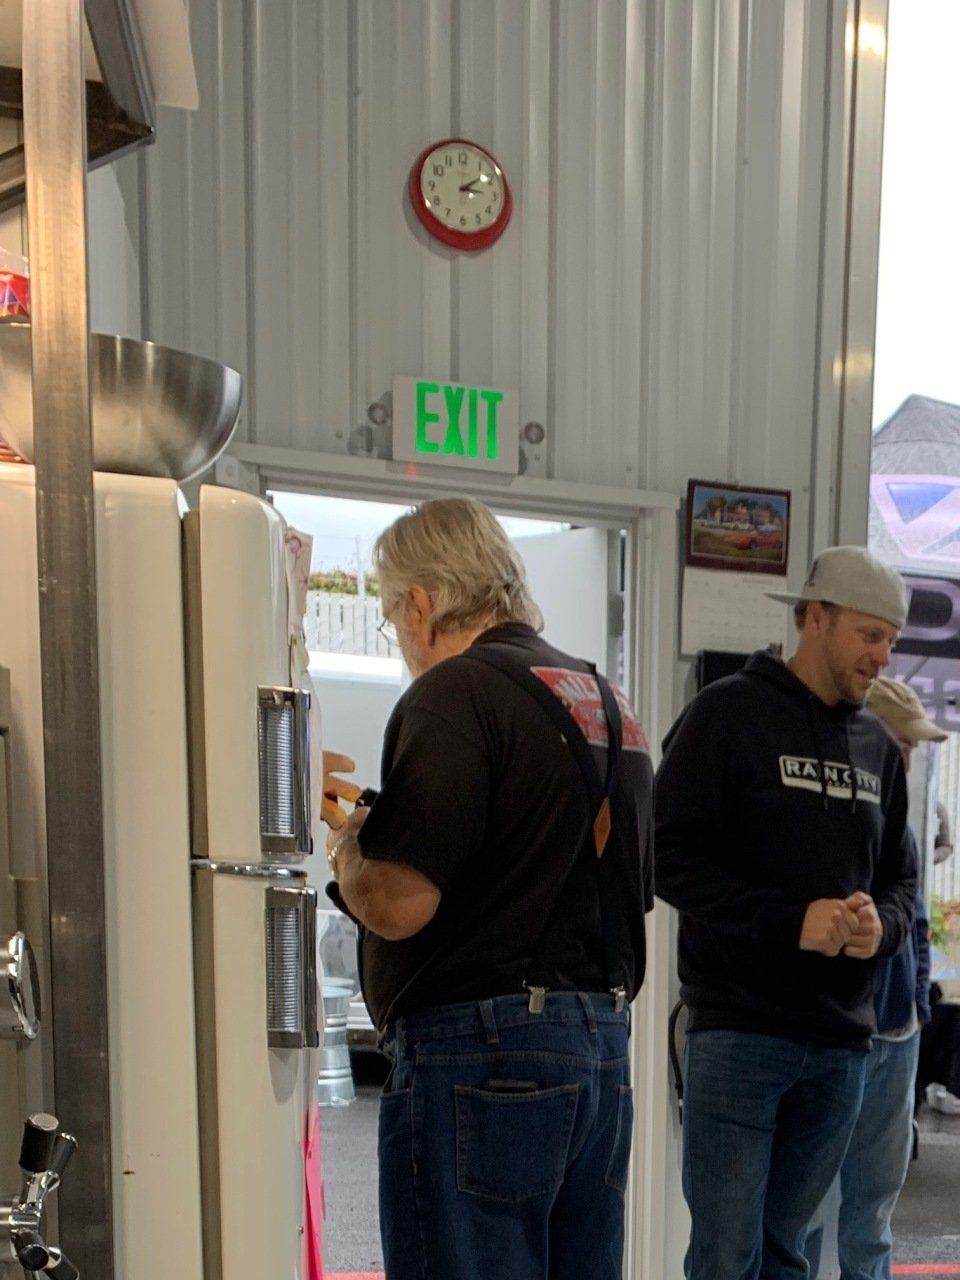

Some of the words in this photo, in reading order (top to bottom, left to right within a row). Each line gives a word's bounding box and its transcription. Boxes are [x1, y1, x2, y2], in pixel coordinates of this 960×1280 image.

[445, 154, 452, 167] 11
[458, 152, 468, 165] 12
[433, 164, 444, 177] 10
[428, 180, 436, 191] 9
[445, 207, 452, 217] 7
[485, 205, 492, 214] 4
[459, 216, 467, 227] 6
[416, 382, 504, 460] EXIT
[785, 760, 838, 781] RAN
